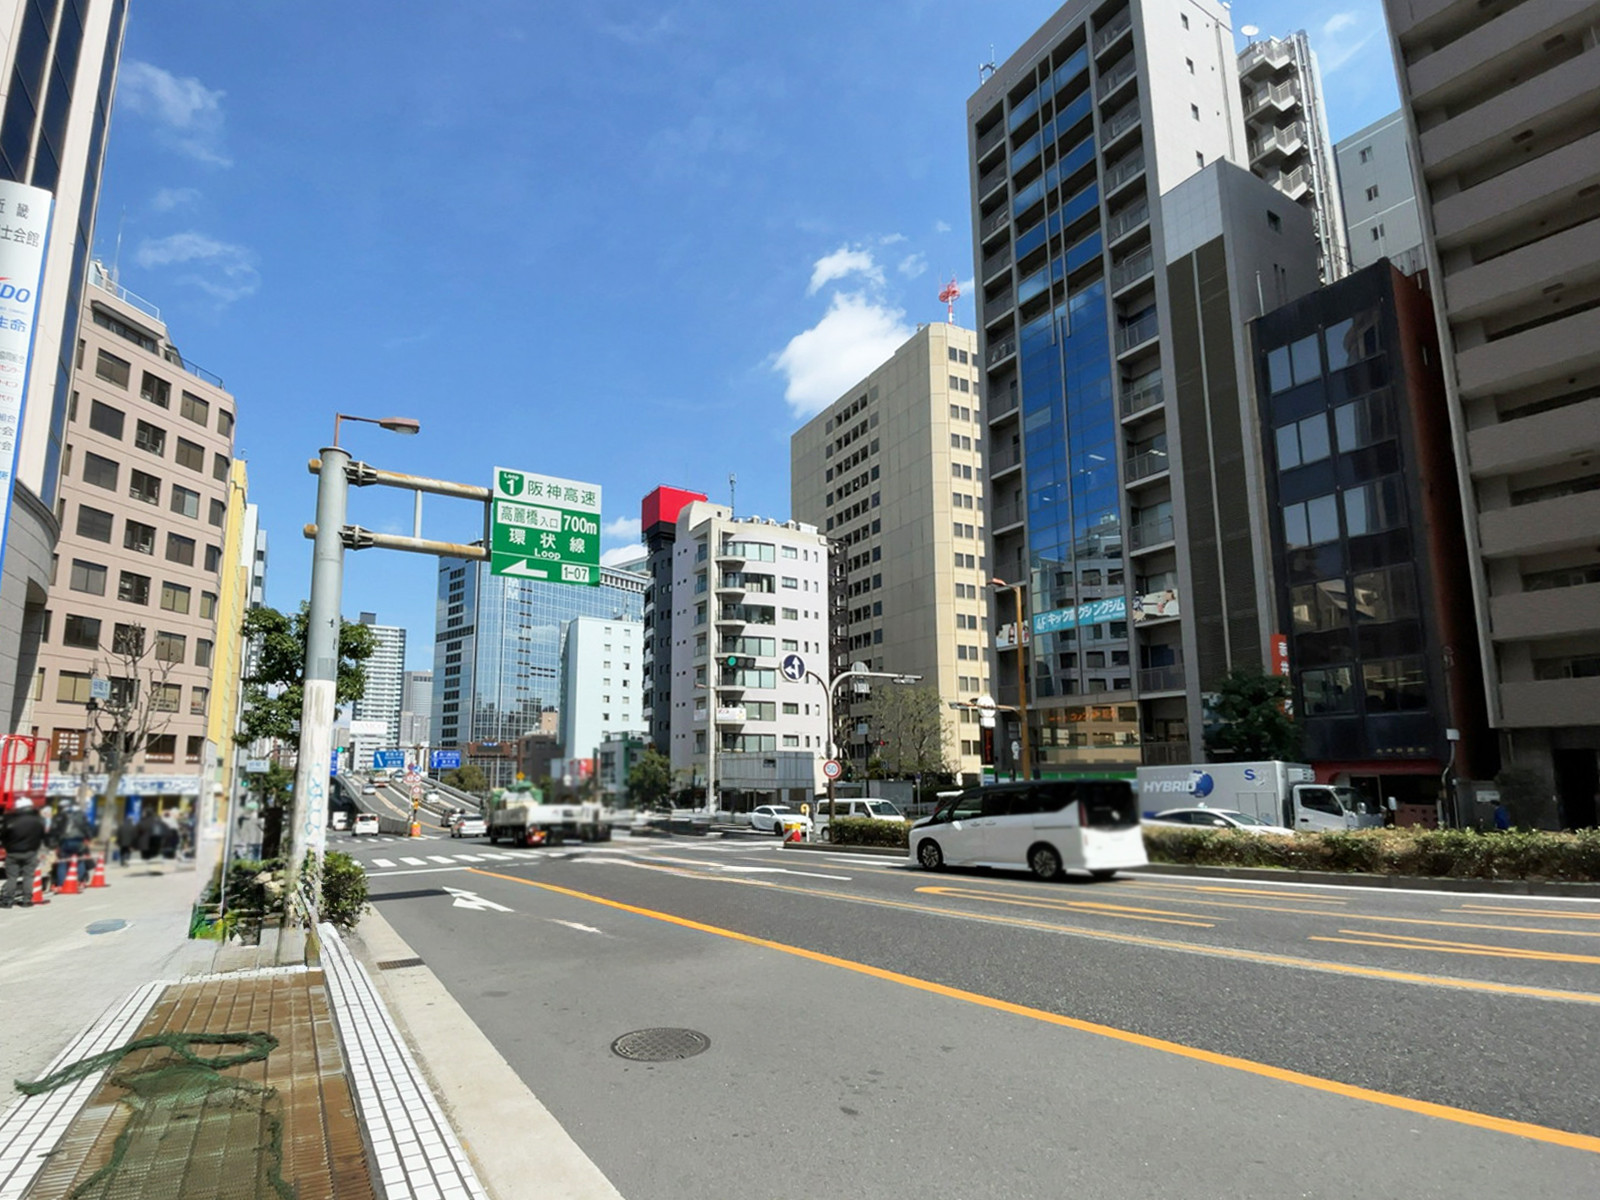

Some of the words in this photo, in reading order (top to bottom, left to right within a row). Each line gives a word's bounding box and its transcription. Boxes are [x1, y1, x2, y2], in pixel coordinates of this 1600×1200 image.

[506, 479, 515, 494] 1
[527, 480, 596, 507] 阪神高速
[563, 515, 597, 535] 700m
[508, 528, 586, 554] 環状線
[534, 547, 561, 560] Loop
[563, 566, 588, 580] 1-07
[1143, 780, 1196, 793] HYBRID
